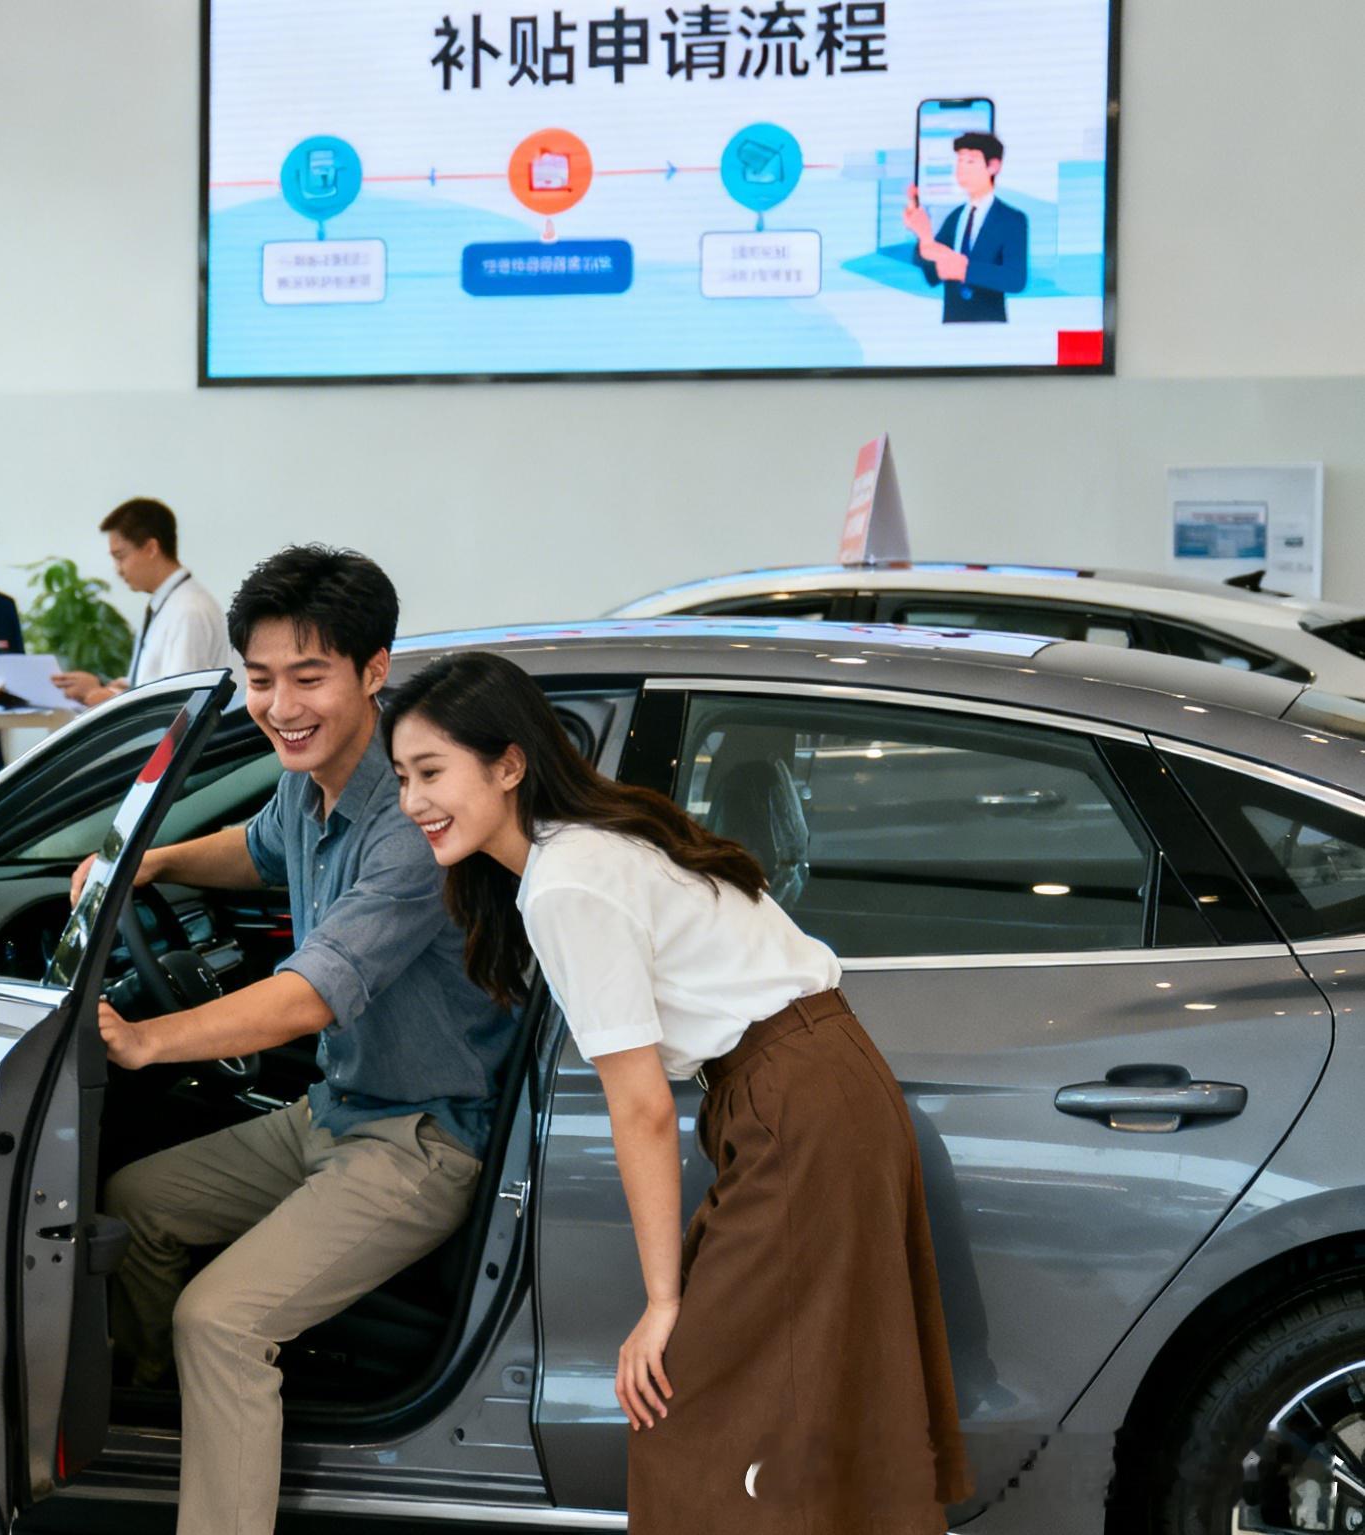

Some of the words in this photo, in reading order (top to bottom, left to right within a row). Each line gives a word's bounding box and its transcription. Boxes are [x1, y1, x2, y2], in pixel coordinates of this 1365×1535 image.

[431, 1, 889, 91] 补贴申请流程
